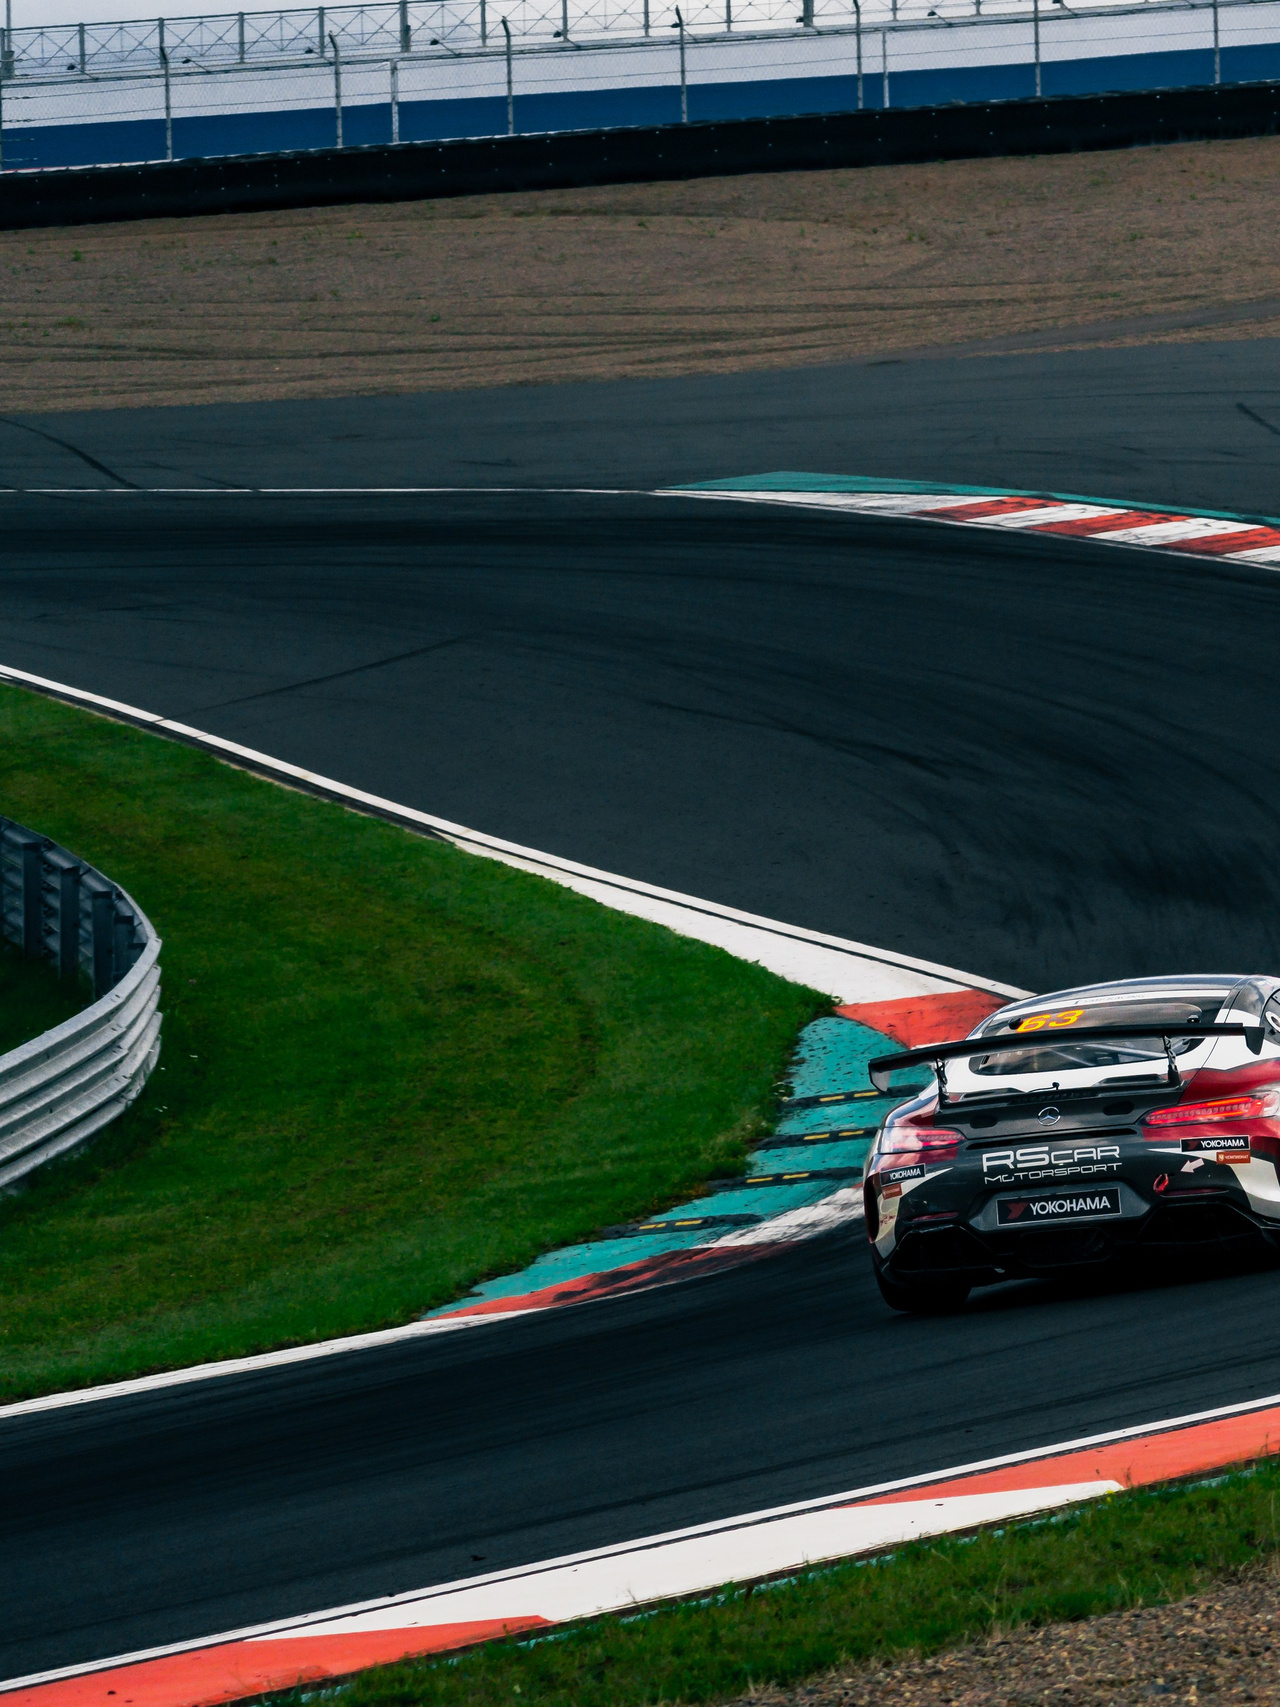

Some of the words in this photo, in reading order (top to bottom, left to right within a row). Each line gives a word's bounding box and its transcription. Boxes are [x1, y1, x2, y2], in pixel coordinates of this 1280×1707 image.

[1016, 1009, 1084, 1032] 63
[1200, 1139, 1245, 1148] YOKOHAMA
[889, 1167, 921, 1181] YOKOHAMA
[984, 1162, 1122, 1184] MOTORSPORT
[1029, 1196, 1111, 1215] YOKOHAMA
